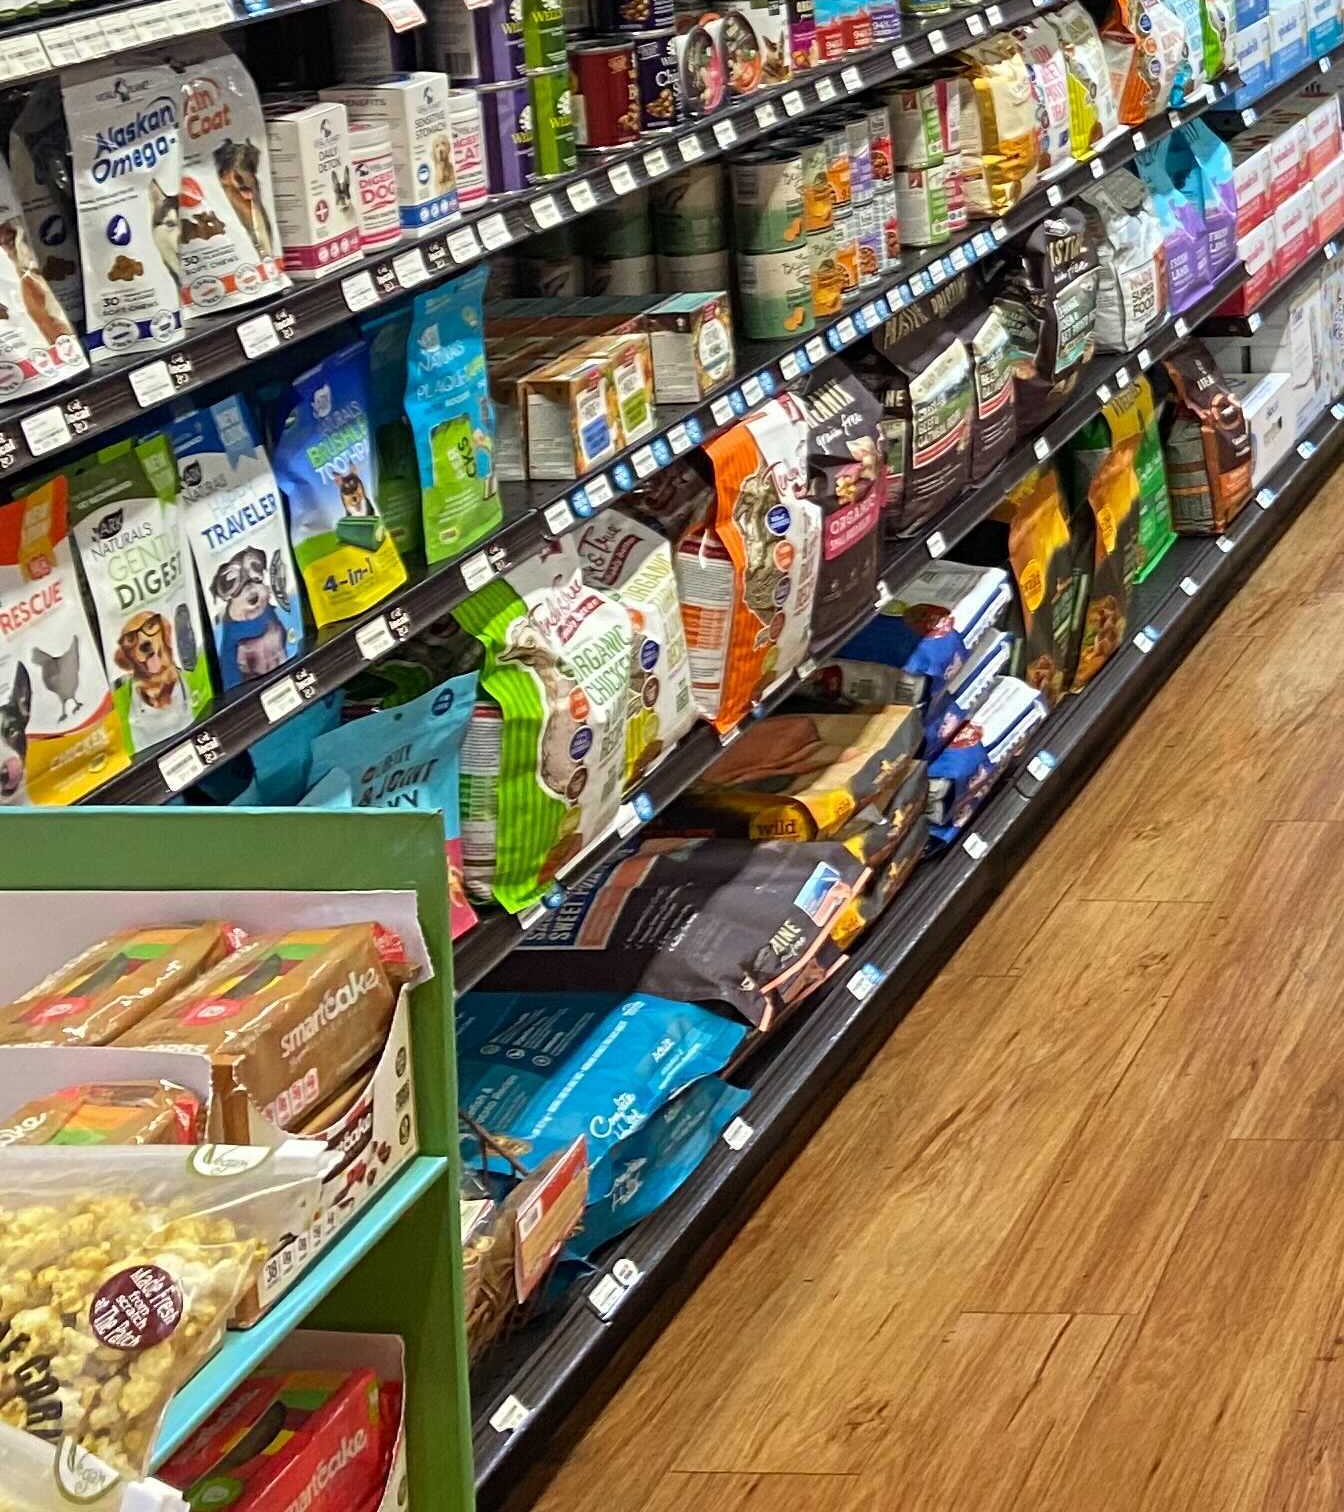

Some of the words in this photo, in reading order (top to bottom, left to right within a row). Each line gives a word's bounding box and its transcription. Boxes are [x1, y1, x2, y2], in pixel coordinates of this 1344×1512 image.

[95, 104, 176, 158] Alaskan
[187, 104, 231, 139] Coat
[89, 521, 153, 562] NATURALS
[200, 492, 278, 550] TRAVELER
[322, 557, 374, 593] 4-in-1
[757, 817, 797, 835] wild
[280, 965, 379, 1064] smartcake
[130, 1268, 166, 1298] Made
[150, 1285, 179, 1324] Fresh
